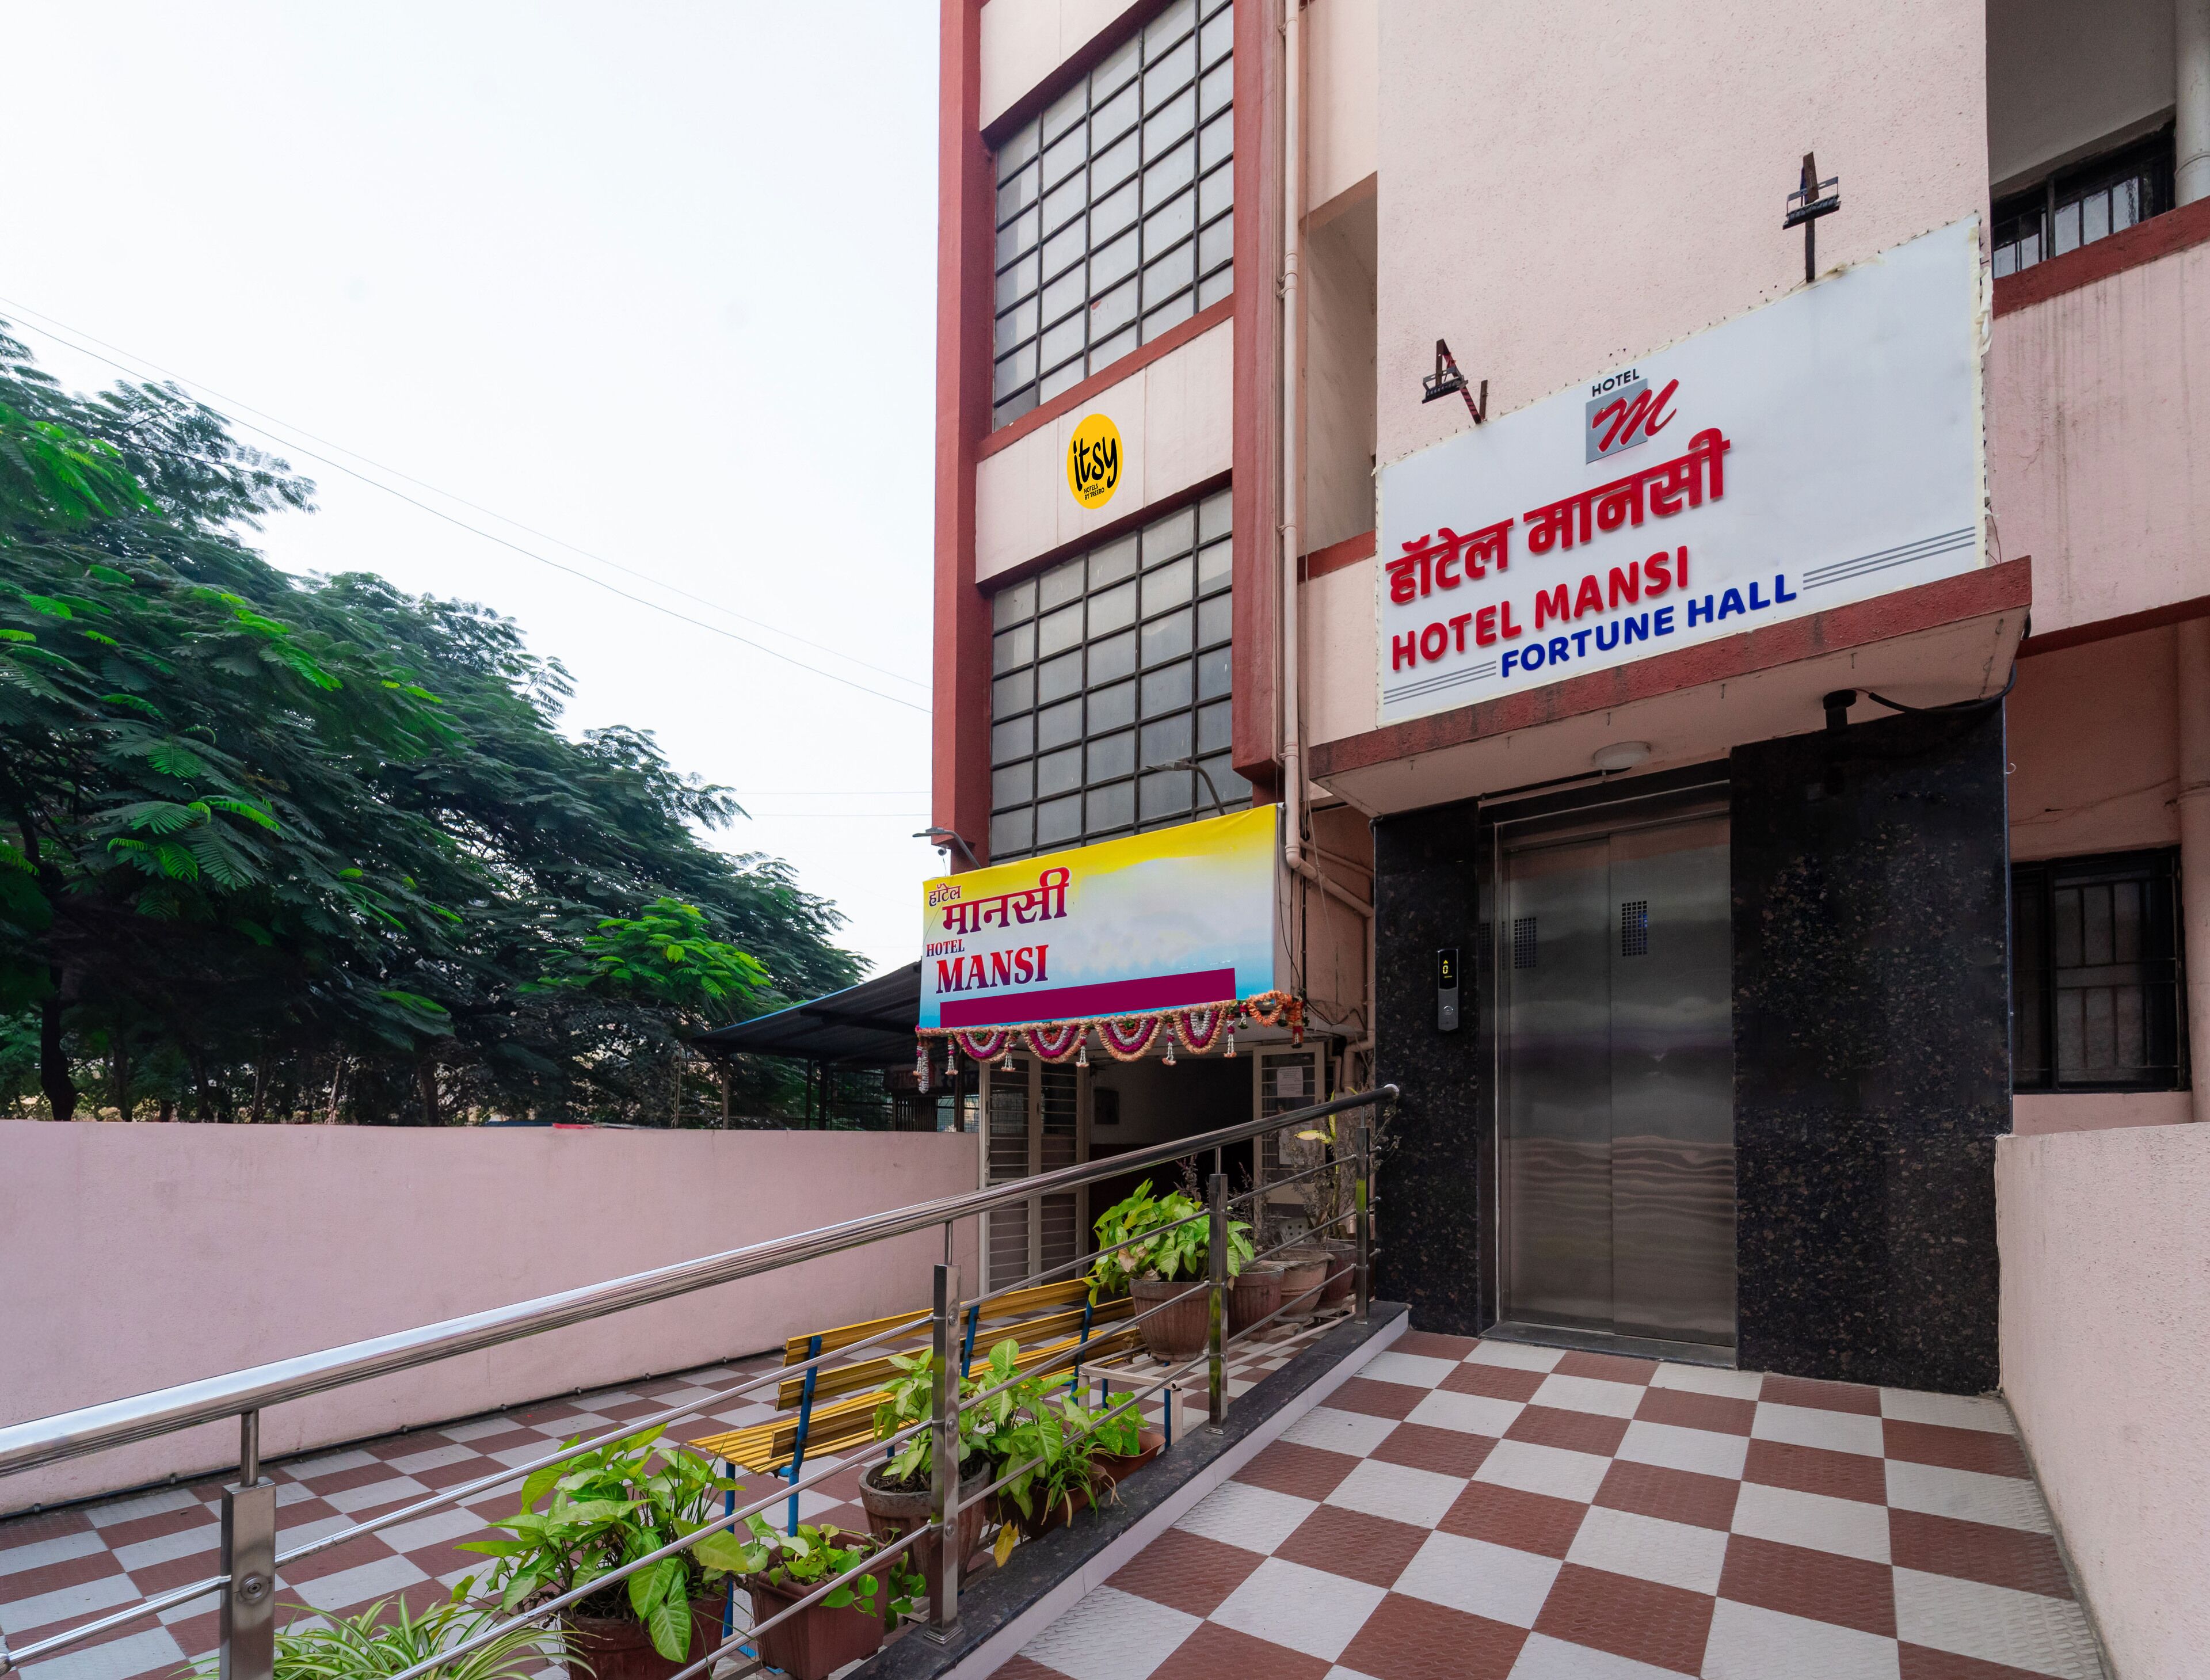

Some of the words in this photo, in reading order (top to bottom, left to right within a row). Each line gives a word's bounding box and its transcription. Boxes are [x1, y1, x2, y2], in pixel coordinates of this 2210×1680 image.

[1592, 368, 1640, 397] HOTEL
[1073, 437, 1118, 492] itsy
[1084, 483, 1098, 494] HOTELS
[1090, 487, 1104, 498] TREEBO
[1385, 518, 1514, 604] हॉटेल
[1523, 428, 1730, 553] मानसी
[1392, 600, 1522, 671] HOTEL
[1535, 545, 1688, 630] MANSI
[1502, 605, 1675, 678] FORTUNE
[1687, 574, 1797, 627] HALL
[928, 883, 961, 906] हॉटेल
[942, 867, 1070, 935] मानसी
[926, 939, 965, 957] HOTEL
[936, 944, 1049, 994] MANSI
[1442, 965, 1448, 974] 0
